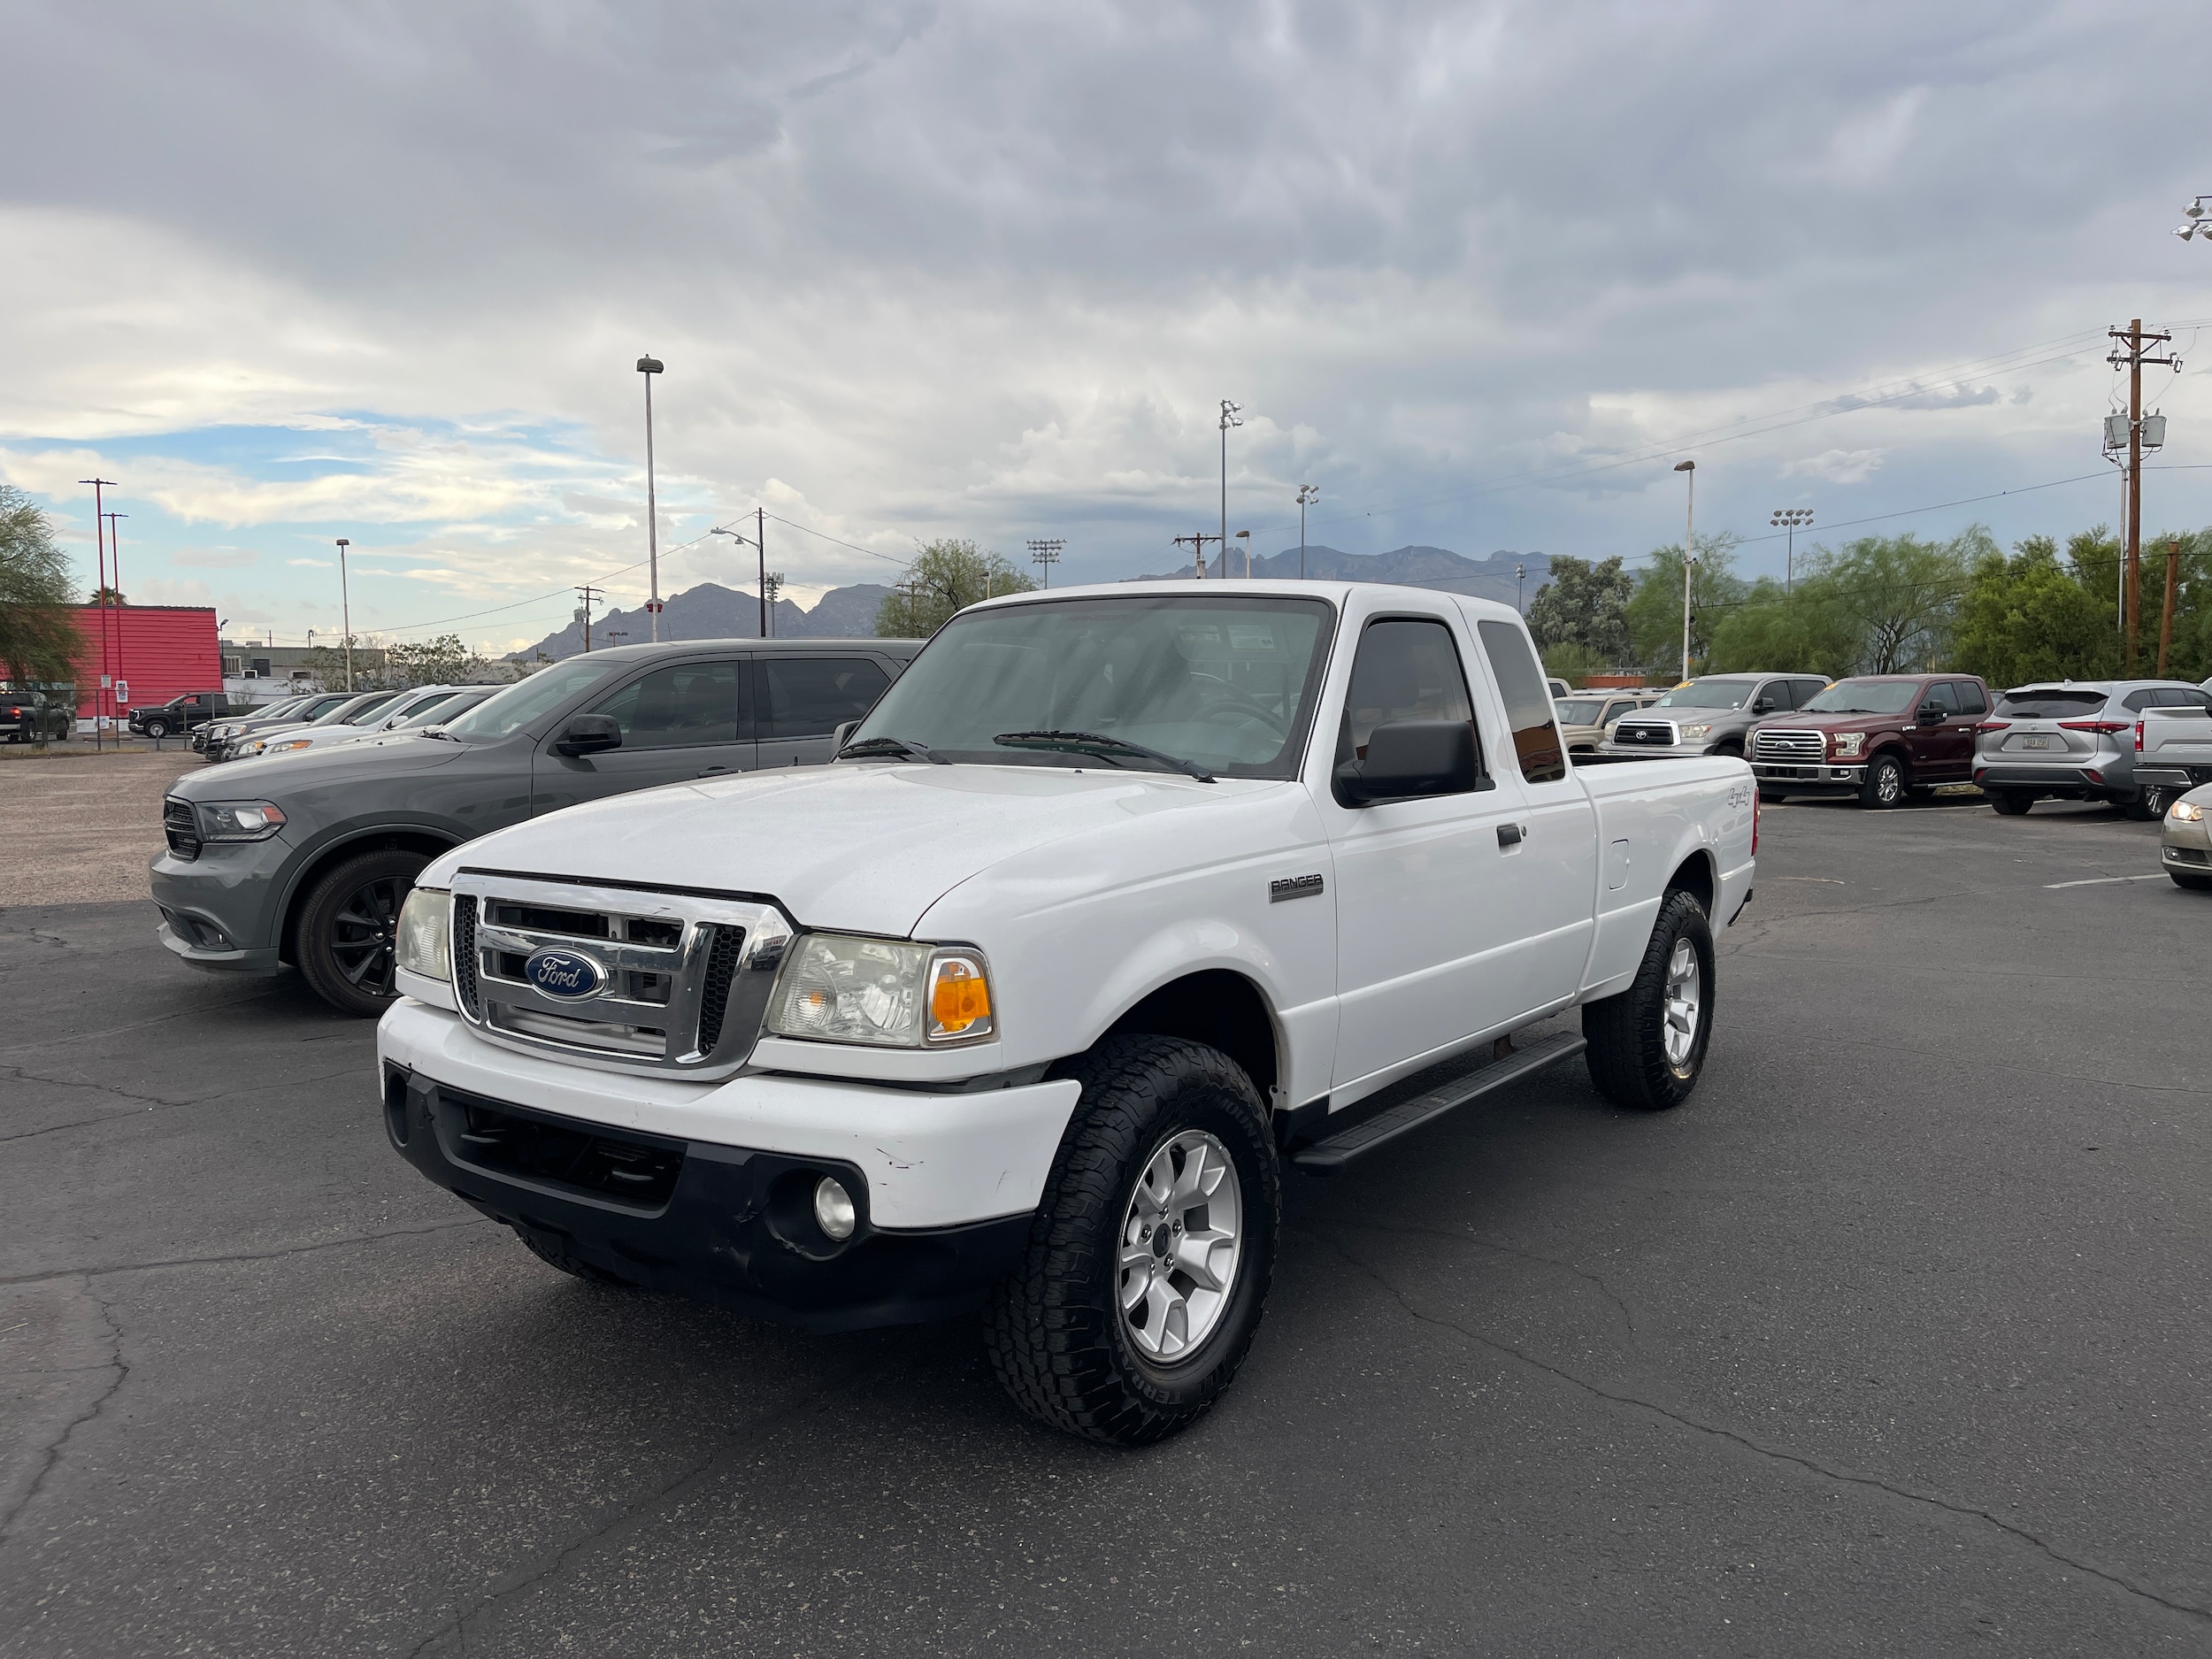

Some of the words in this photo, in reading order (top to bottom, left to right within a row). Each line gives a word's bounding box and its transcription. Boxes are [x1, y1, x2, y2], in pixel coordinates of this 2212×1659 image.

[1727, 786, 1749, 808] 4x4
[1271, 873, 1323, 893] RANGER
[537, 956, 581, 988] Ford
